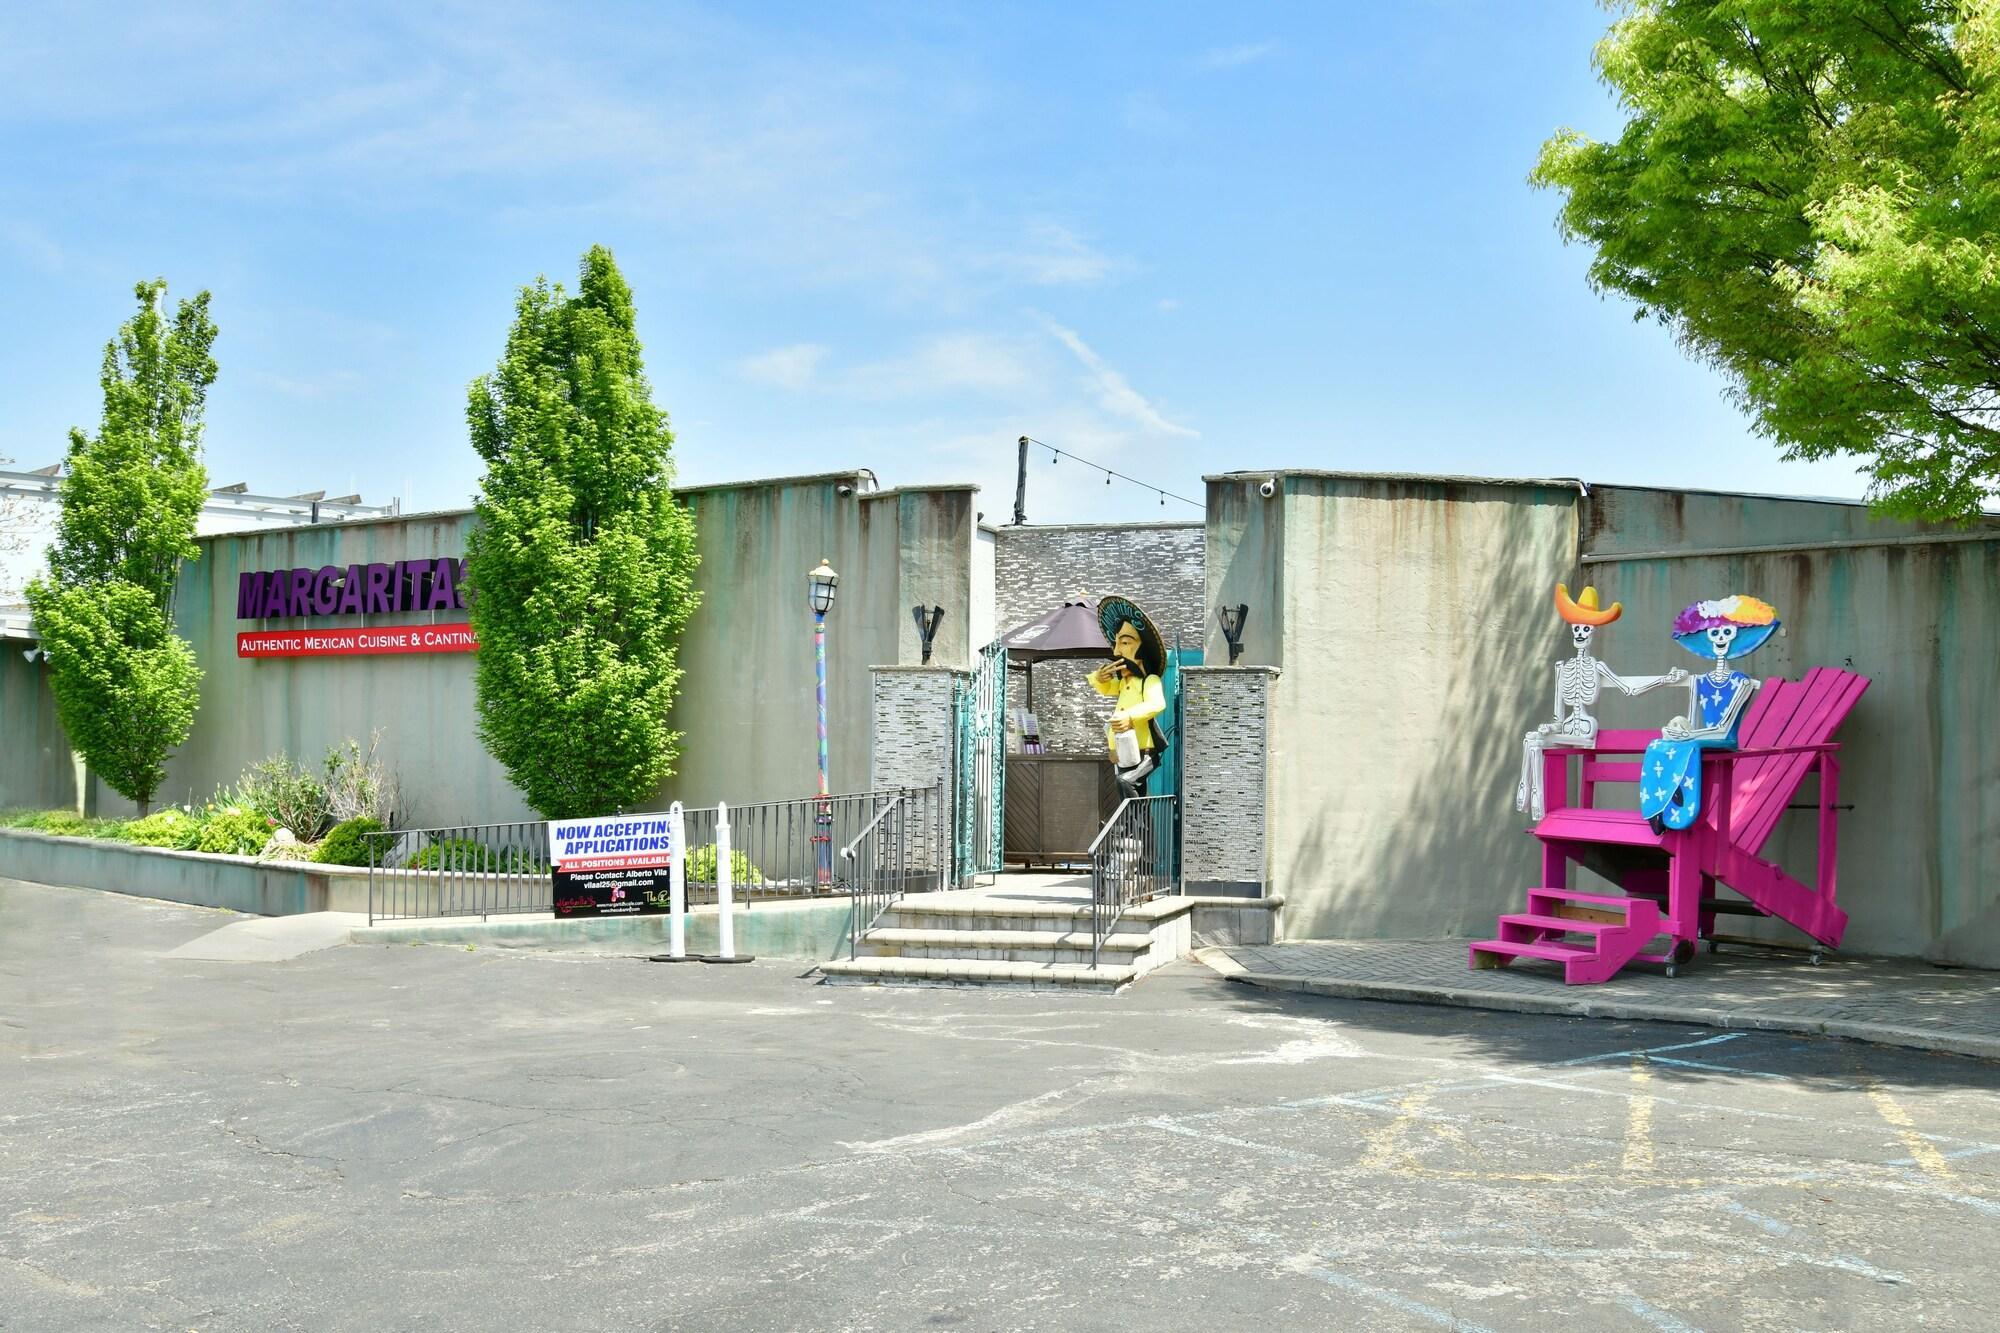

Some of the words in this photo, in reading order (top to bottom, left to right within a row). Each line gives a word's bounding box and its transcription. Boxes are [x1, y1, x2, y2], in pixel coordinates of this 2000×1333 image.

[411, 632, 421, 646] &
[556, 825, 592, 840] NOW
[593, 820, 671, 838] ACCEPTIN
[564, 836, 669, 855] APPLICATIONS
[564, 861, 580, 869] ALL
[581, 858, 625, 868] POSITIONS
[570, 873, 594, 881] Please
[594, 871, 625, 879] Contact:
[625, 869, 652, 878] Alberto
